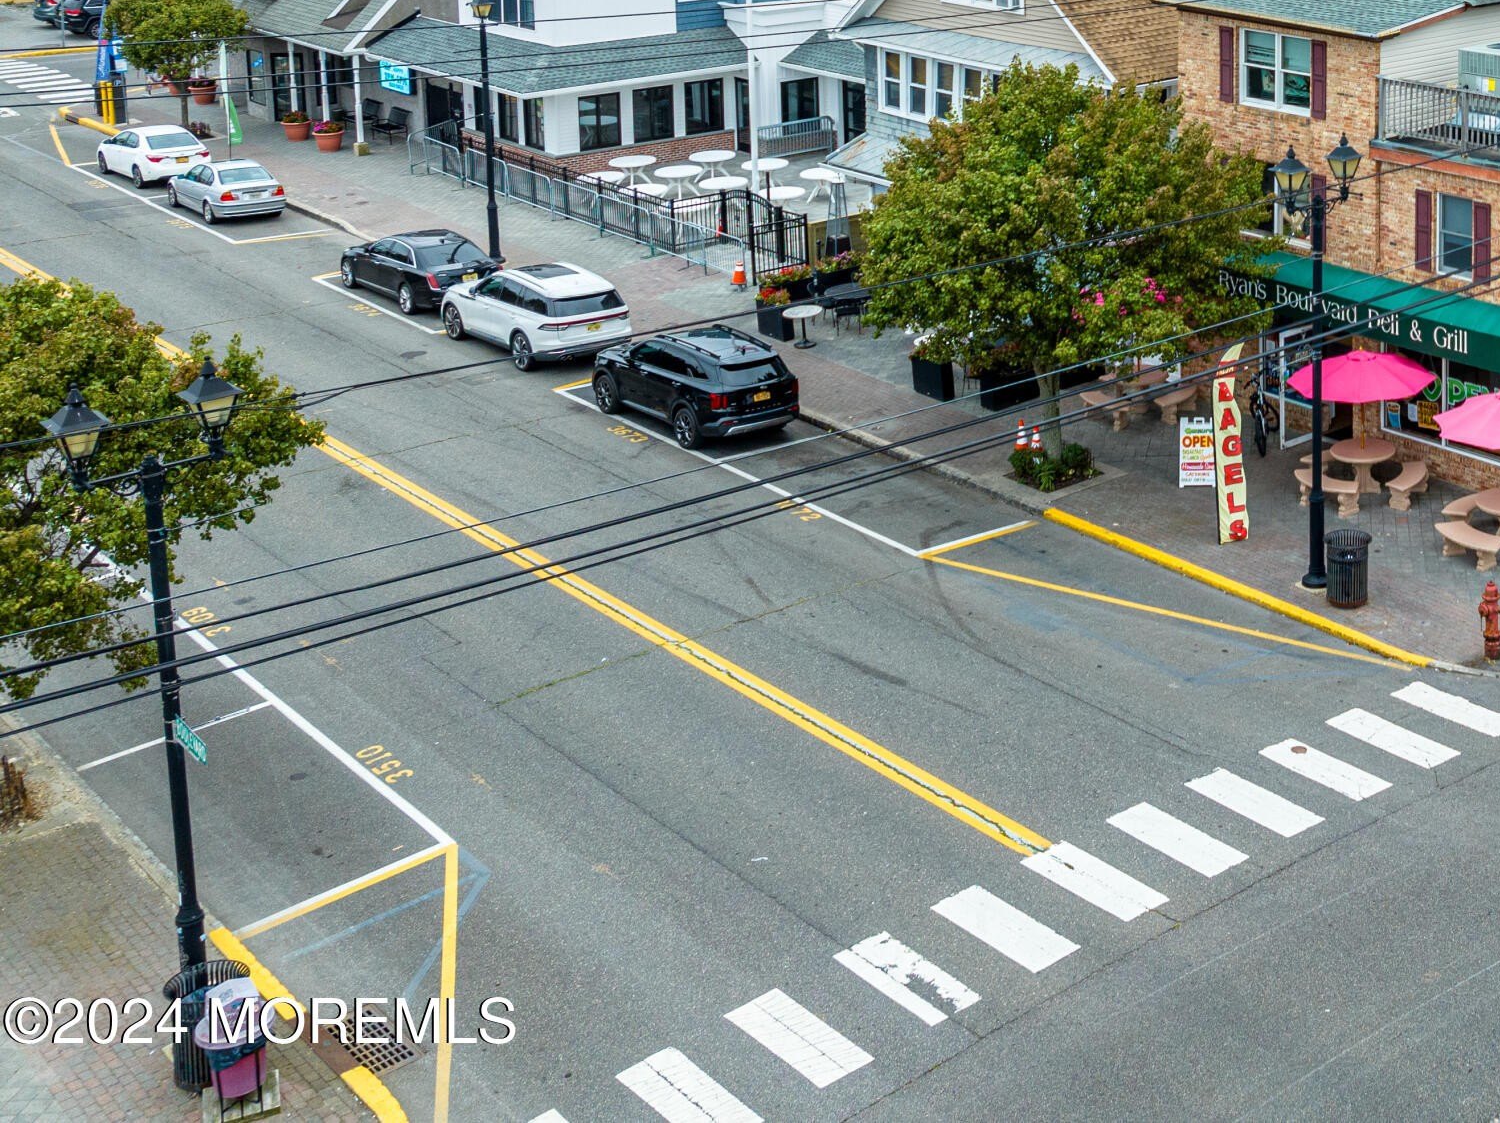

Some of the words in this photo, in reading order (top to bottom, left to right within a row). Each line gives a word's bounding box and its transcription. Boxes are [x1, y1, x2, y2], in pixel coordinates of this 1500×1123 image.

[1276, 285, 1357, 324] Boulvard
[1409, 319, 1422, 343] &
[1433, 325, 1468, 355] Grill
[1422, 372, 1500, 406] OPE
[1182, 435, 1214, 448] OPEN
[1218, 381, 1250, 542] BAGELS
